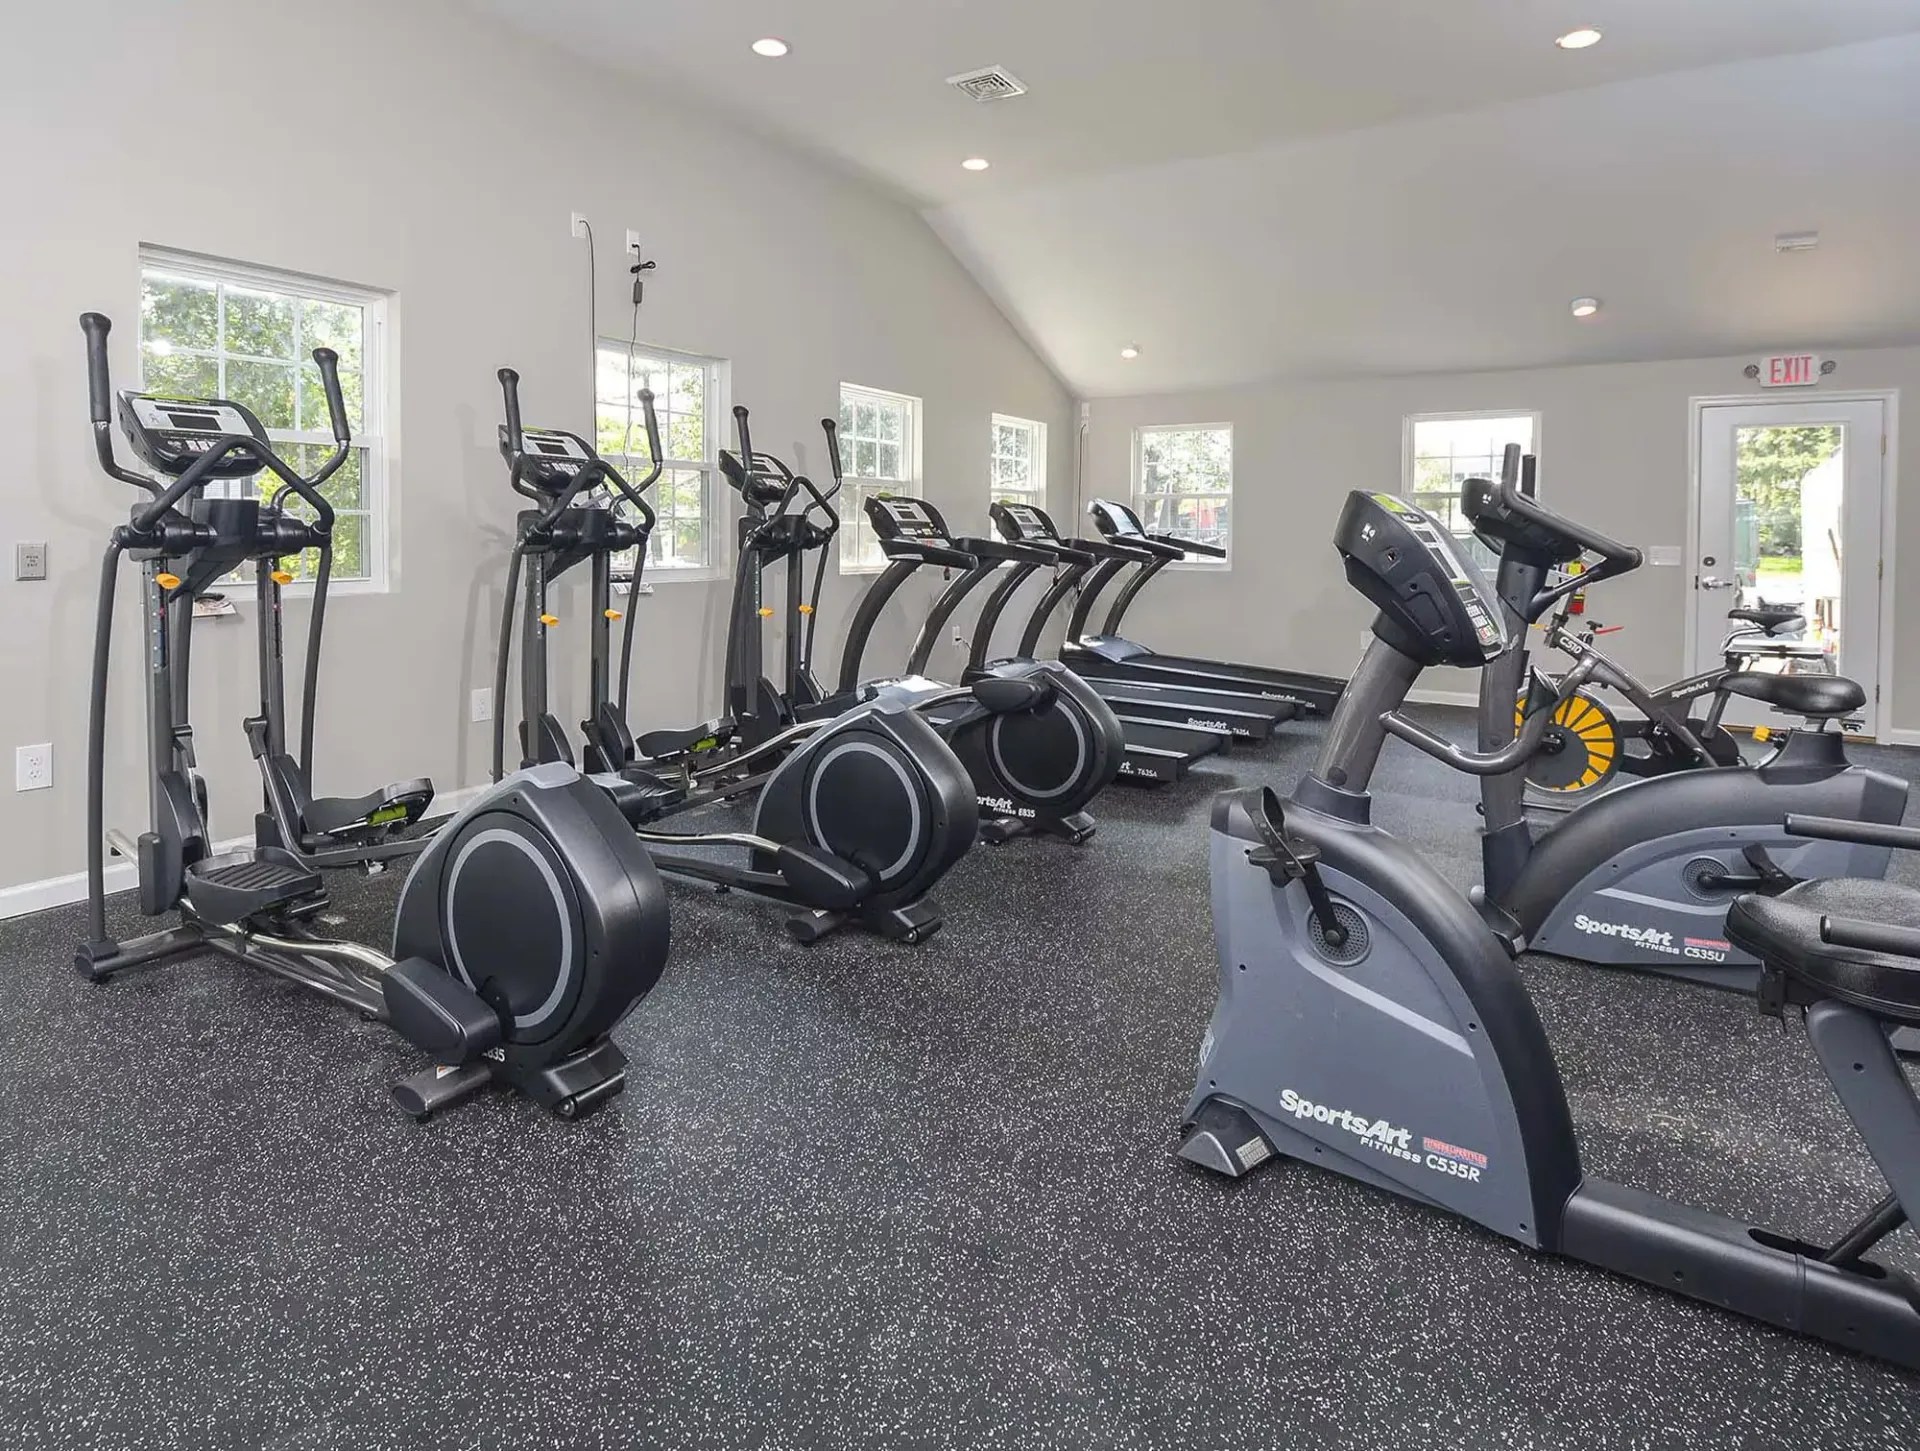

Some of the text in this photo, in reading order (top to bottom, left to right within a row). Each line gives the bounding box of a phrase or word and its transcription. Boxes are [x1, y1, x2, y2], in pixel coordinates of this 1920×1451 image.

[1770, 356, 1812, 384] EXIT
[1559, 637, 1583, 654] C510
[1671, 681, 1709, 698] SportsArt
[1018, 808, 1036, 818] E835
[1574, 914, 1673, 946] SportsArt
[1634, 941, 1680, 955] FITNESS
[1684, 946, 1725, 962] C535U
[1279, 1088, 1412, 1149] SportsArt
[1360, 1136, 1422, 1164] FITNESS
[1425, 1153, 1481, 1183] C535R
